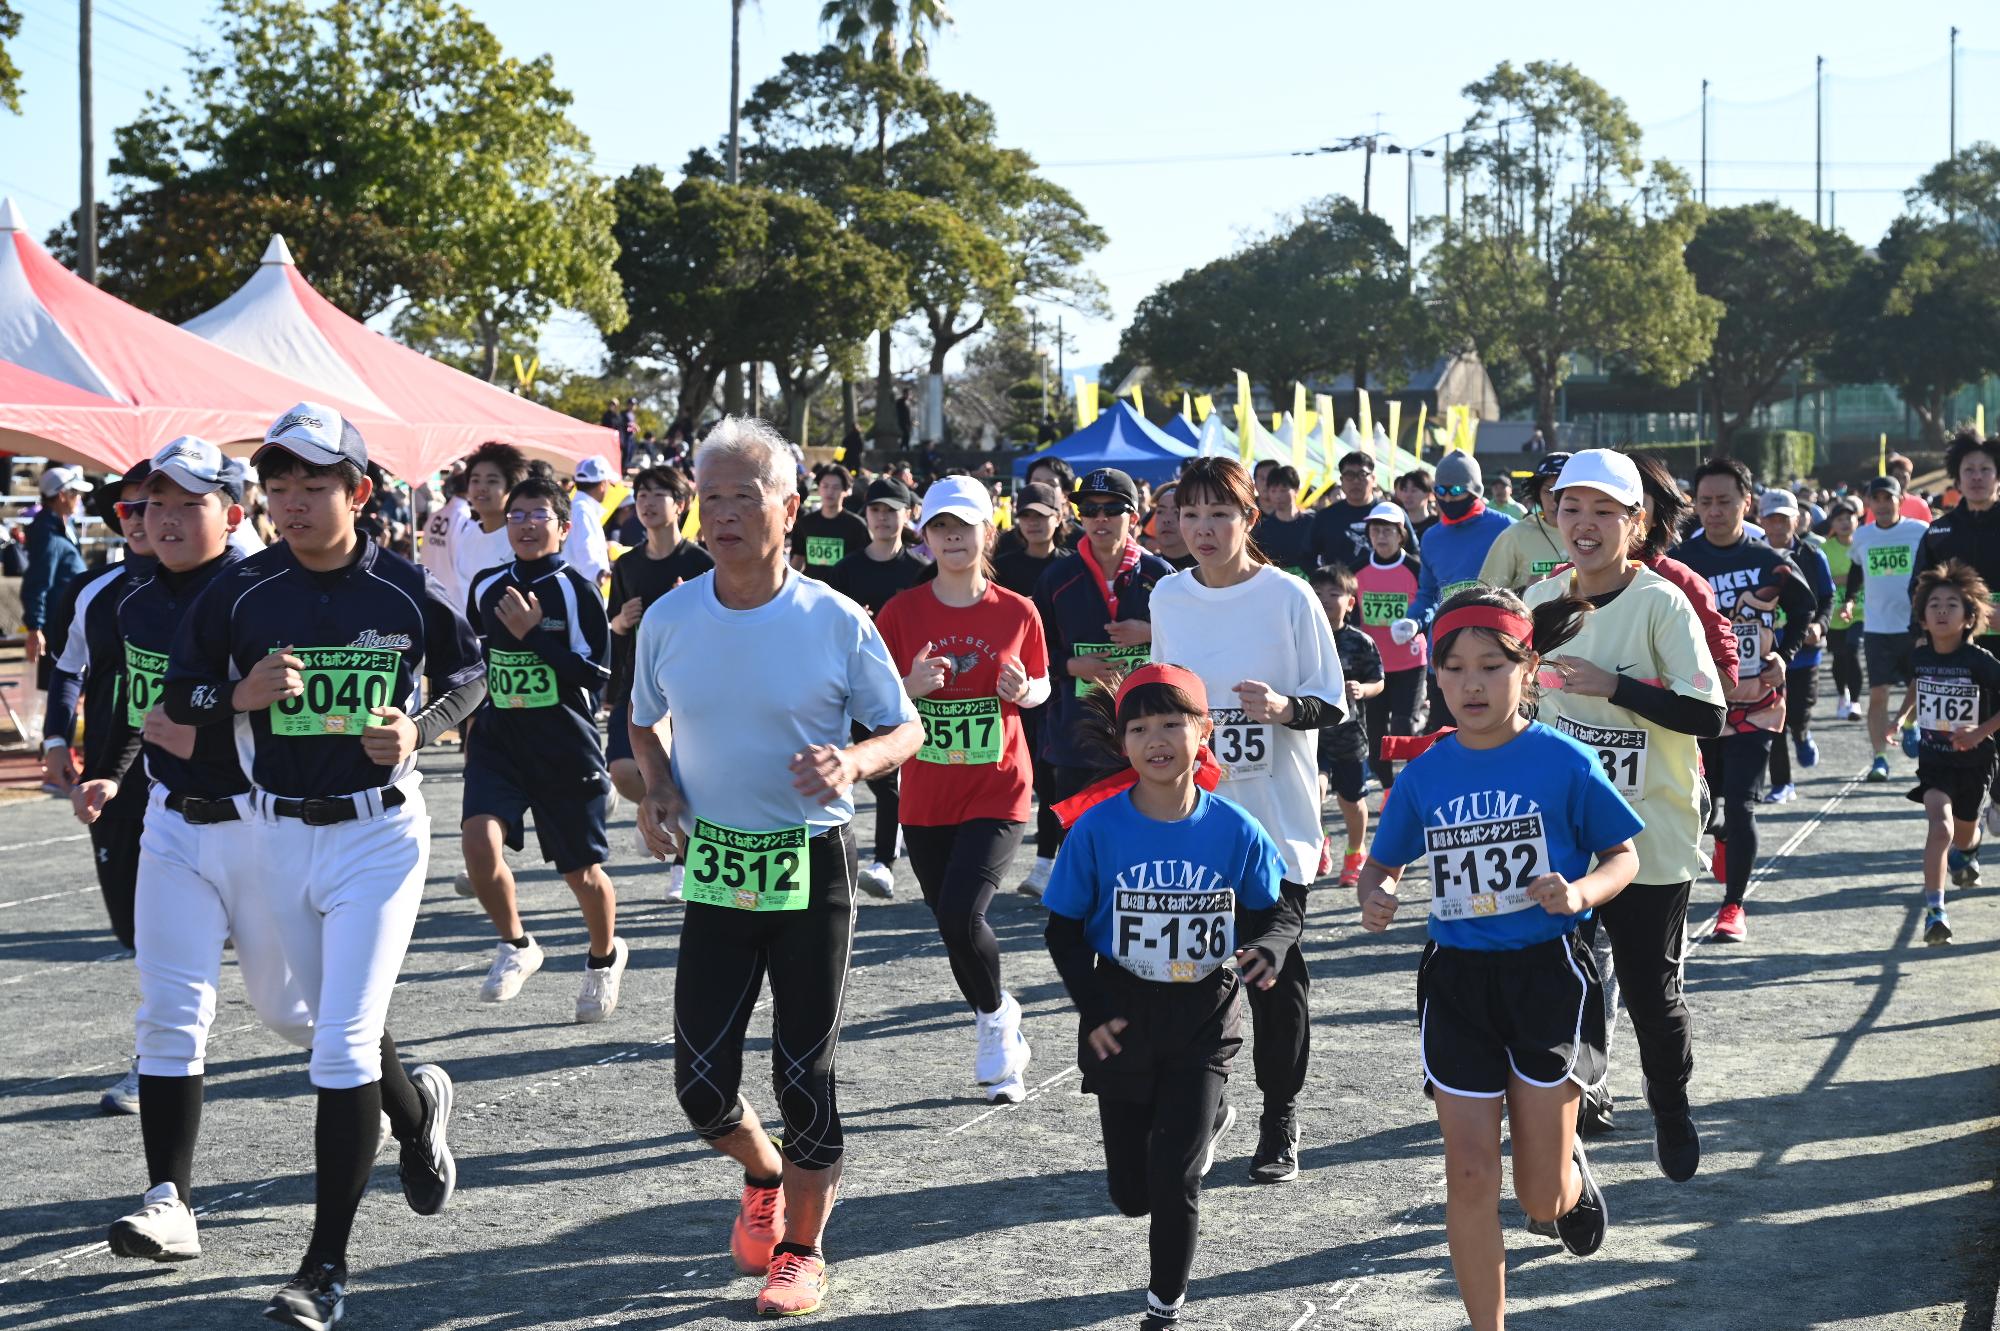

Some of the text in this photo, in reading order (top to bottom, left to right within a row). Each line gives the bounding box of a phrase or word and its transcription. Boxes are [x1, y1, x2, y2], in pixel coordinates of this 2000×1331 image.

[808, 544, 840, 559] 8061
[1869, 553, 1908, 570] 3406
[1364, 602, 1404, 619] 3736
[297, 651, 371, 667] あくねボンタン
[926, 636, 999, 660] ONT-BELL
[1739, 637, 1755, 659] 9
[490, 667, 551, 695] 8023
[1919, 694, 1974, 721] F-162
[1434, 790, 1539, 826] IZUMI
[692, 843, 800, 893] 3512
[1116, 860, 1223, 890] IZUMI
[1434, 843, 1541, 898] F-132
[1119, 915, 1226, 960] F-136
